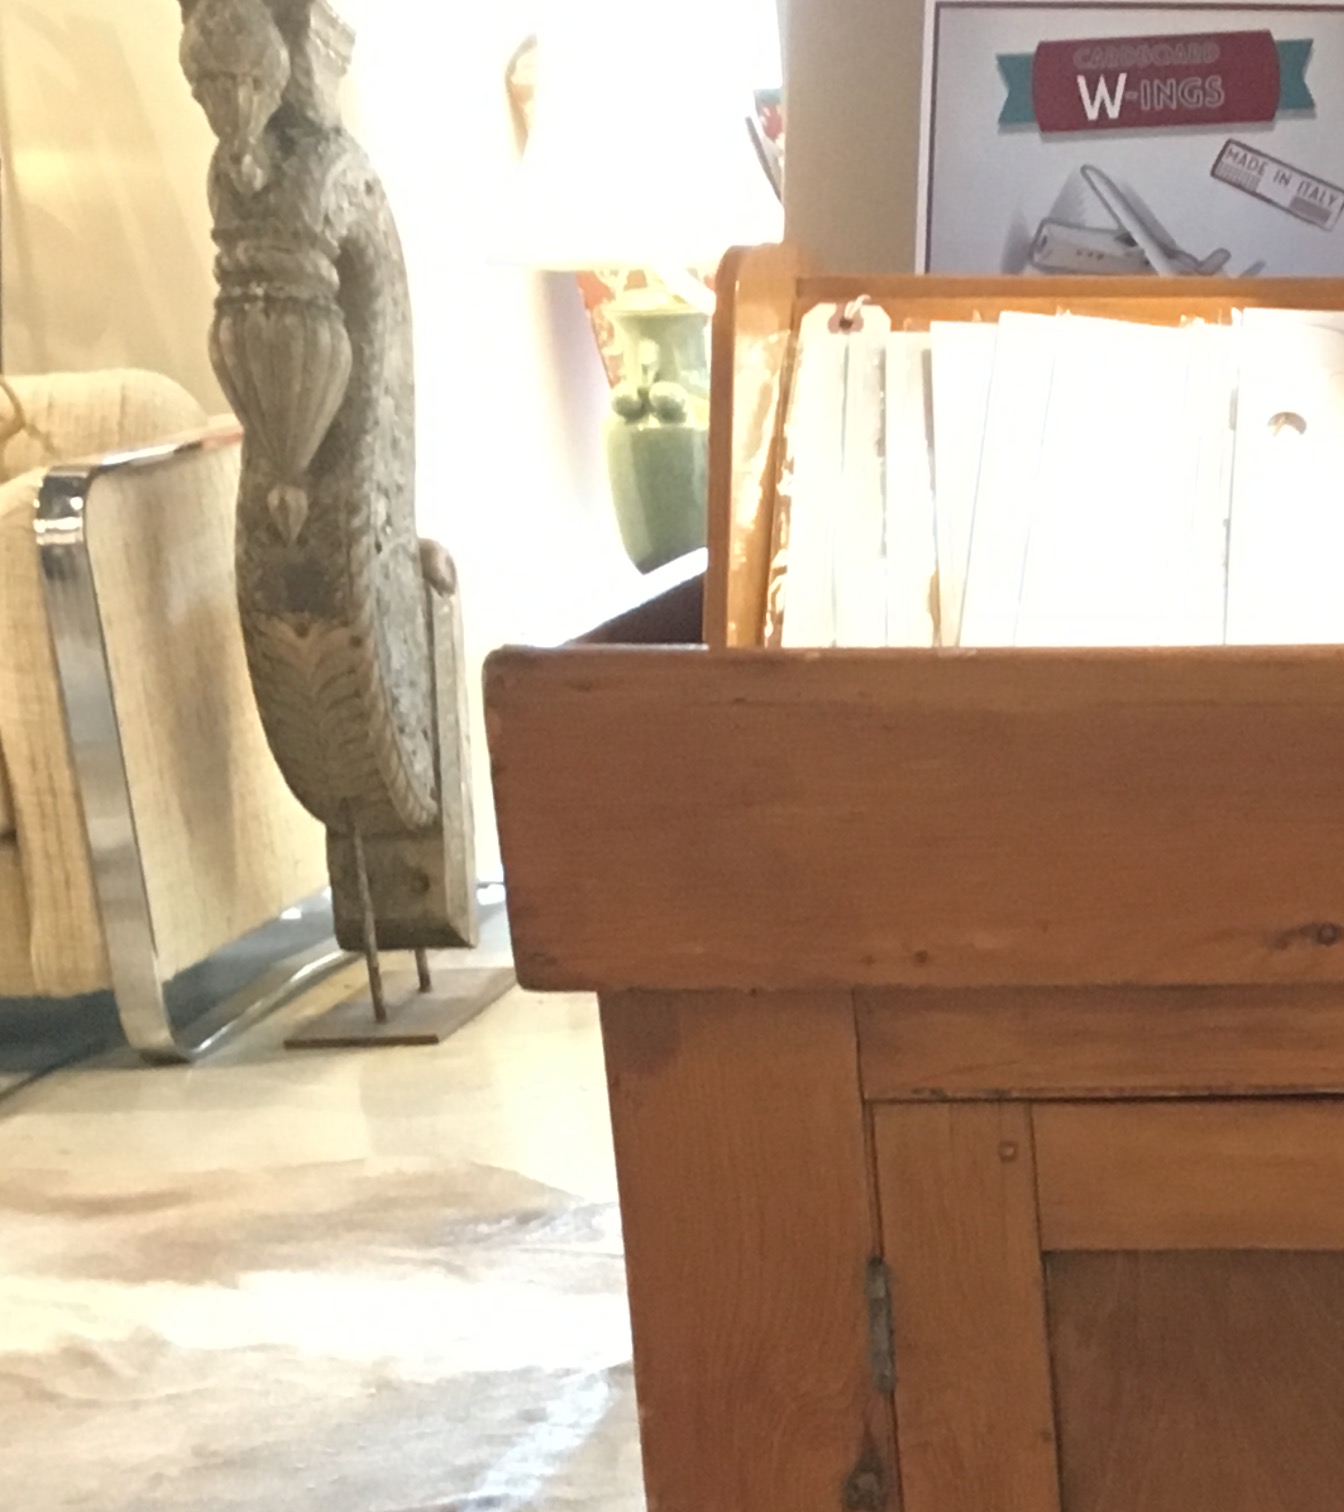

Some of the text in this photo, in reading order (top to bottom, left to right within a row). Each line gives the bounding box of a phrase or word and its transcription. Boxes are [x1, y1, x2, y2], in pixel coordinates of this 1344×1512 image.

[1076, 73, 1225, 121] W-INGS
[1226, 147, 1339, 207] MADE IN ITALY
